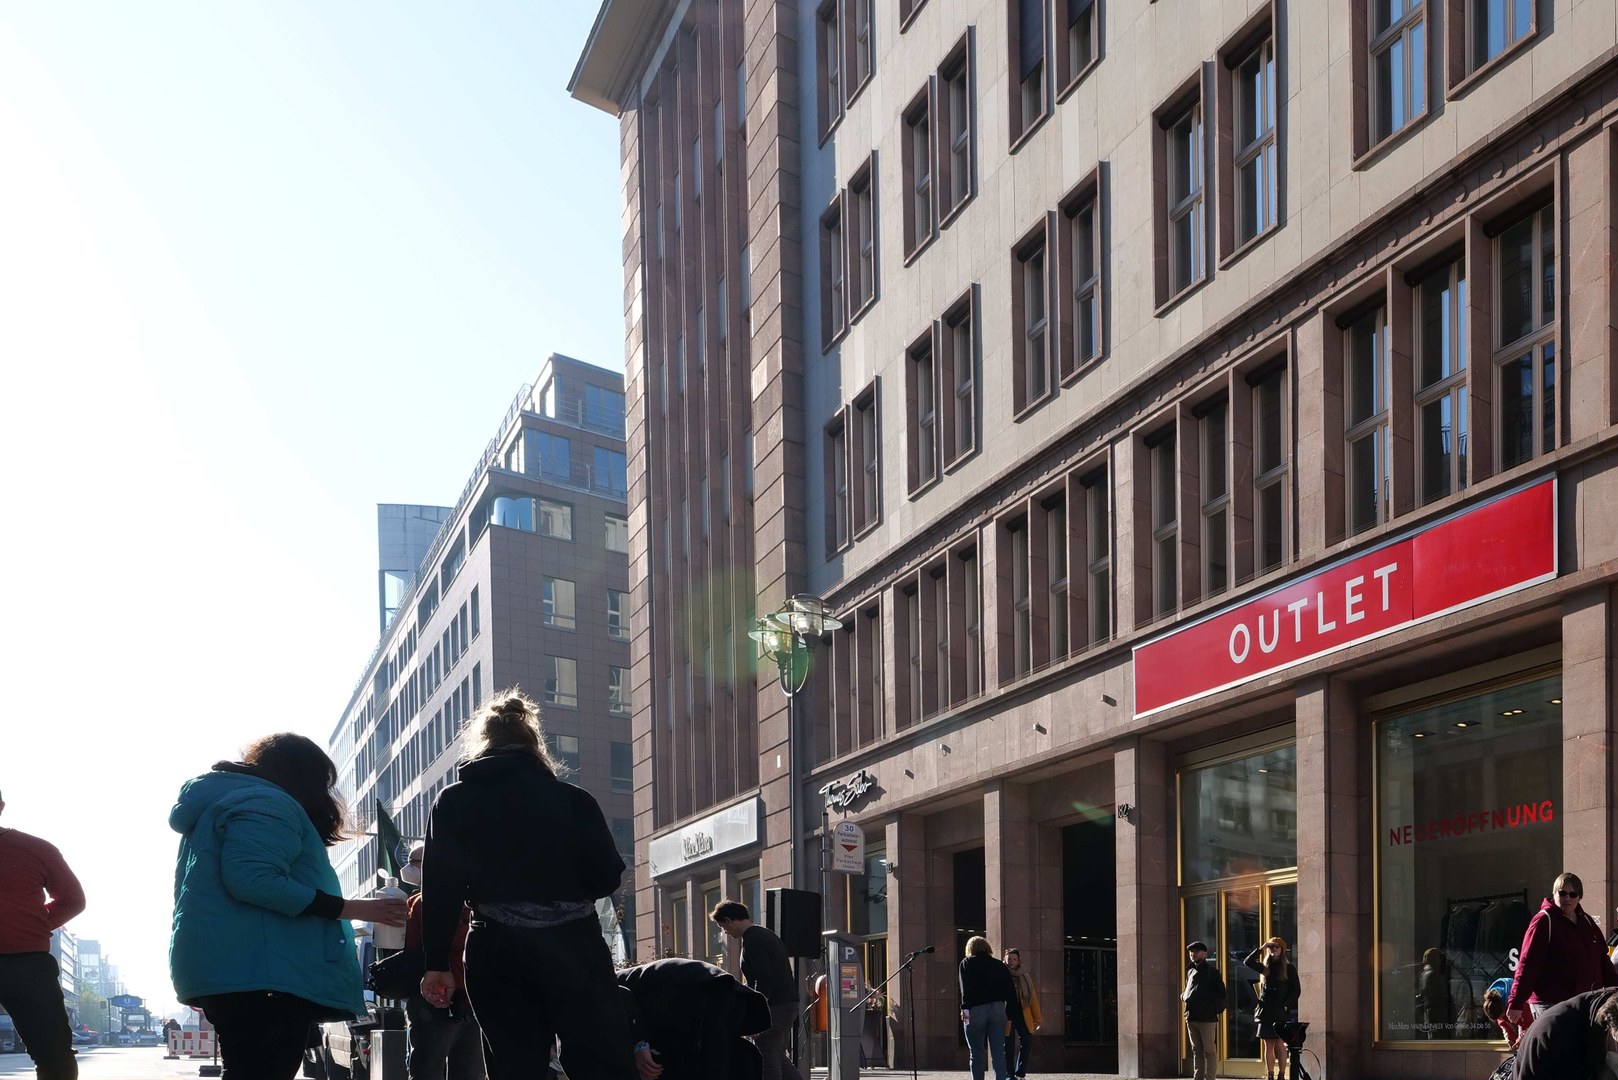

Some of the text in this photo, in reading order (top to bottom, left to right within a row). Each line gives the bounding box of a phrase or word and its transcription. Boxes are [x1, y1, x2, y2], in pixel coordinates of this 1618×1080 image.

[1229, 562, 1398, 664] OUTLET
[844, 824, 854, 832] 30
[1389, 800, 1554, 847] NEUERÖFFNUNG
[845, 946, 855, 960] P
